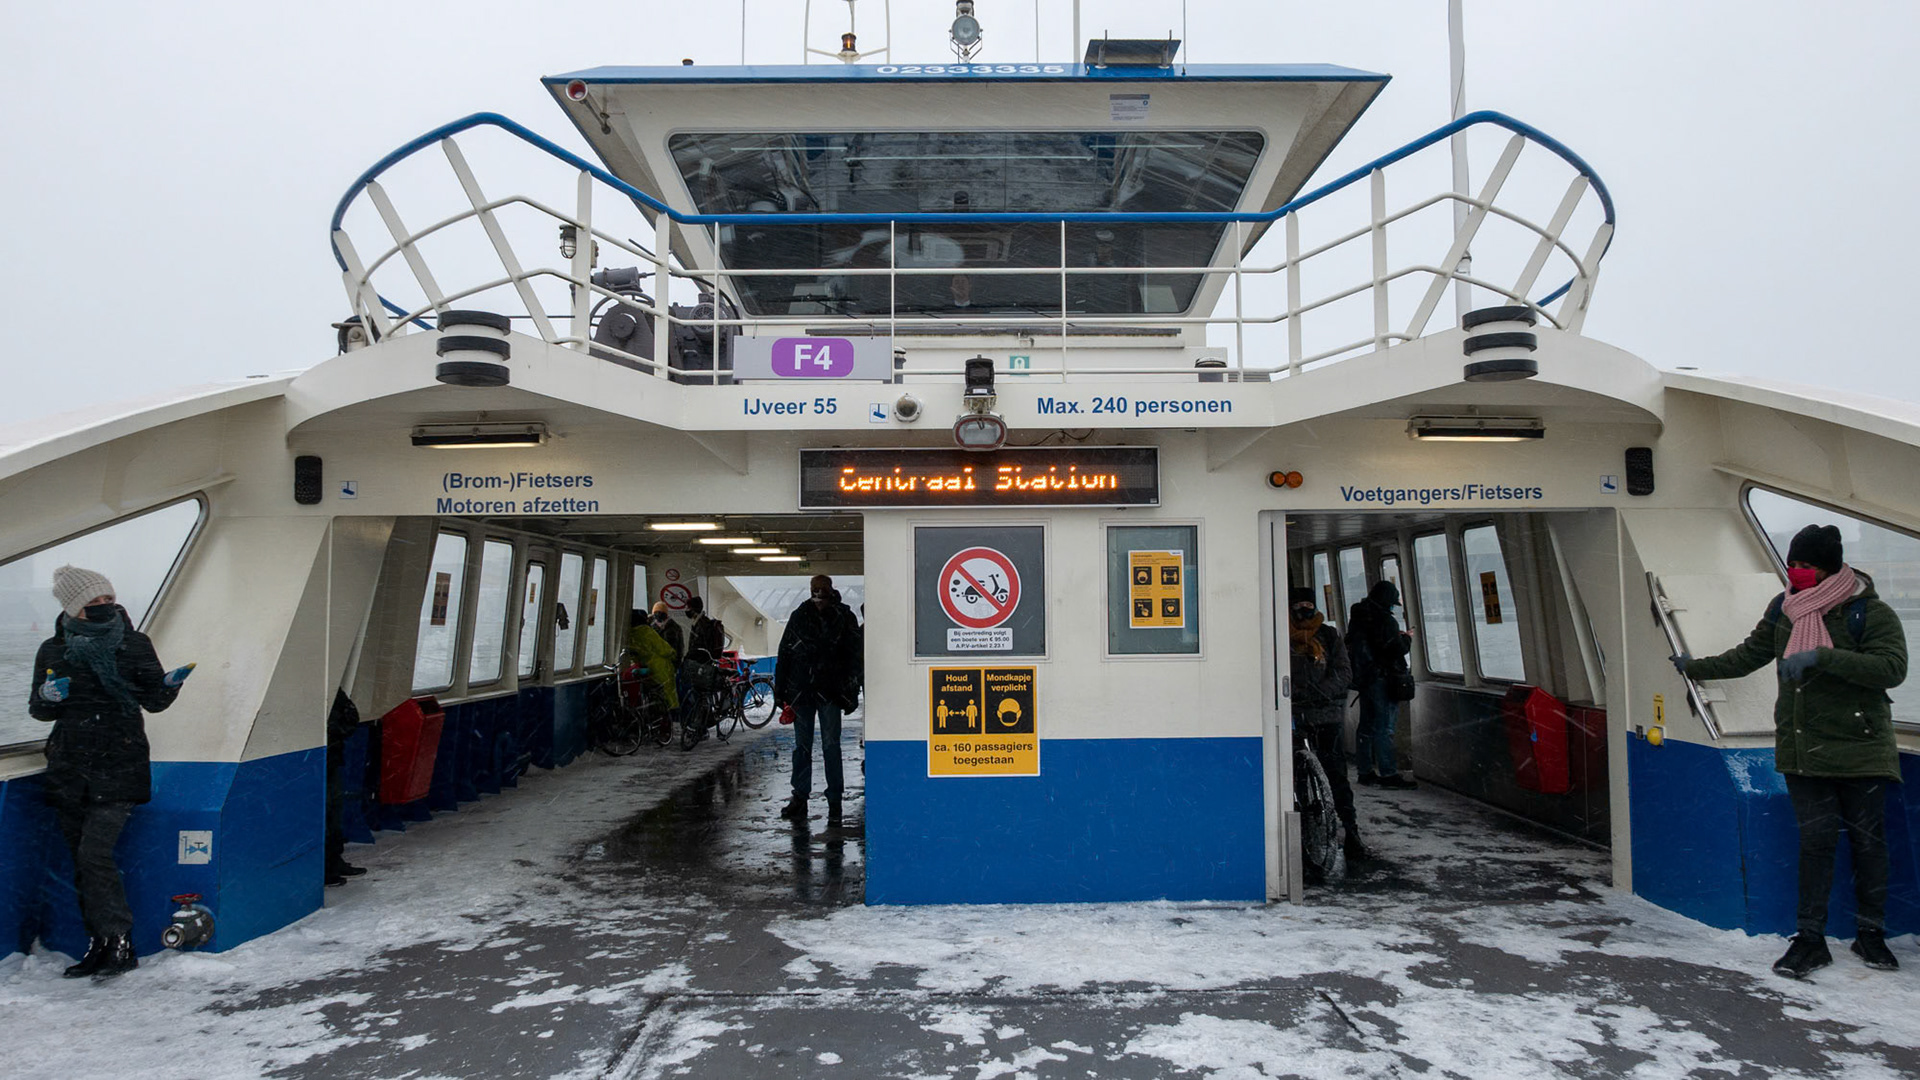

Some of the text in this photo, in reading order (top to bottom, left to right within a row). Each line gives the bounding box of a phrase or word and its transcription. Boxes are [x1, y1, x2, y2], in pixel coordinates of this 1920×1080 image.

[876, 65, 1065, 74] 02333335
[794, 344, 833, 371] F4
[744, 398, 837, 415] IJveer 55
[1037, 397, 1232, 417] Max. 240 personen
[442, 472, 594, 493] (Brom-)Fietsers
[840, 466, 1118, 491] Centraal Station
[1340, 484, 1543, 505] Voetgangers/Fietsers
[436, 497, 599, 514] Motoren afzetten
[945, 674, 968, 682] Houd
[986, 673, 1032, 683] Mondkapje
[941, 684, 973, 692] afstand
[991, 683, 1027, 693] verplicht
[934, 741, 1033, 753] ca. 160 passagiers
[953, 755, 1014, 767] toegestaan
